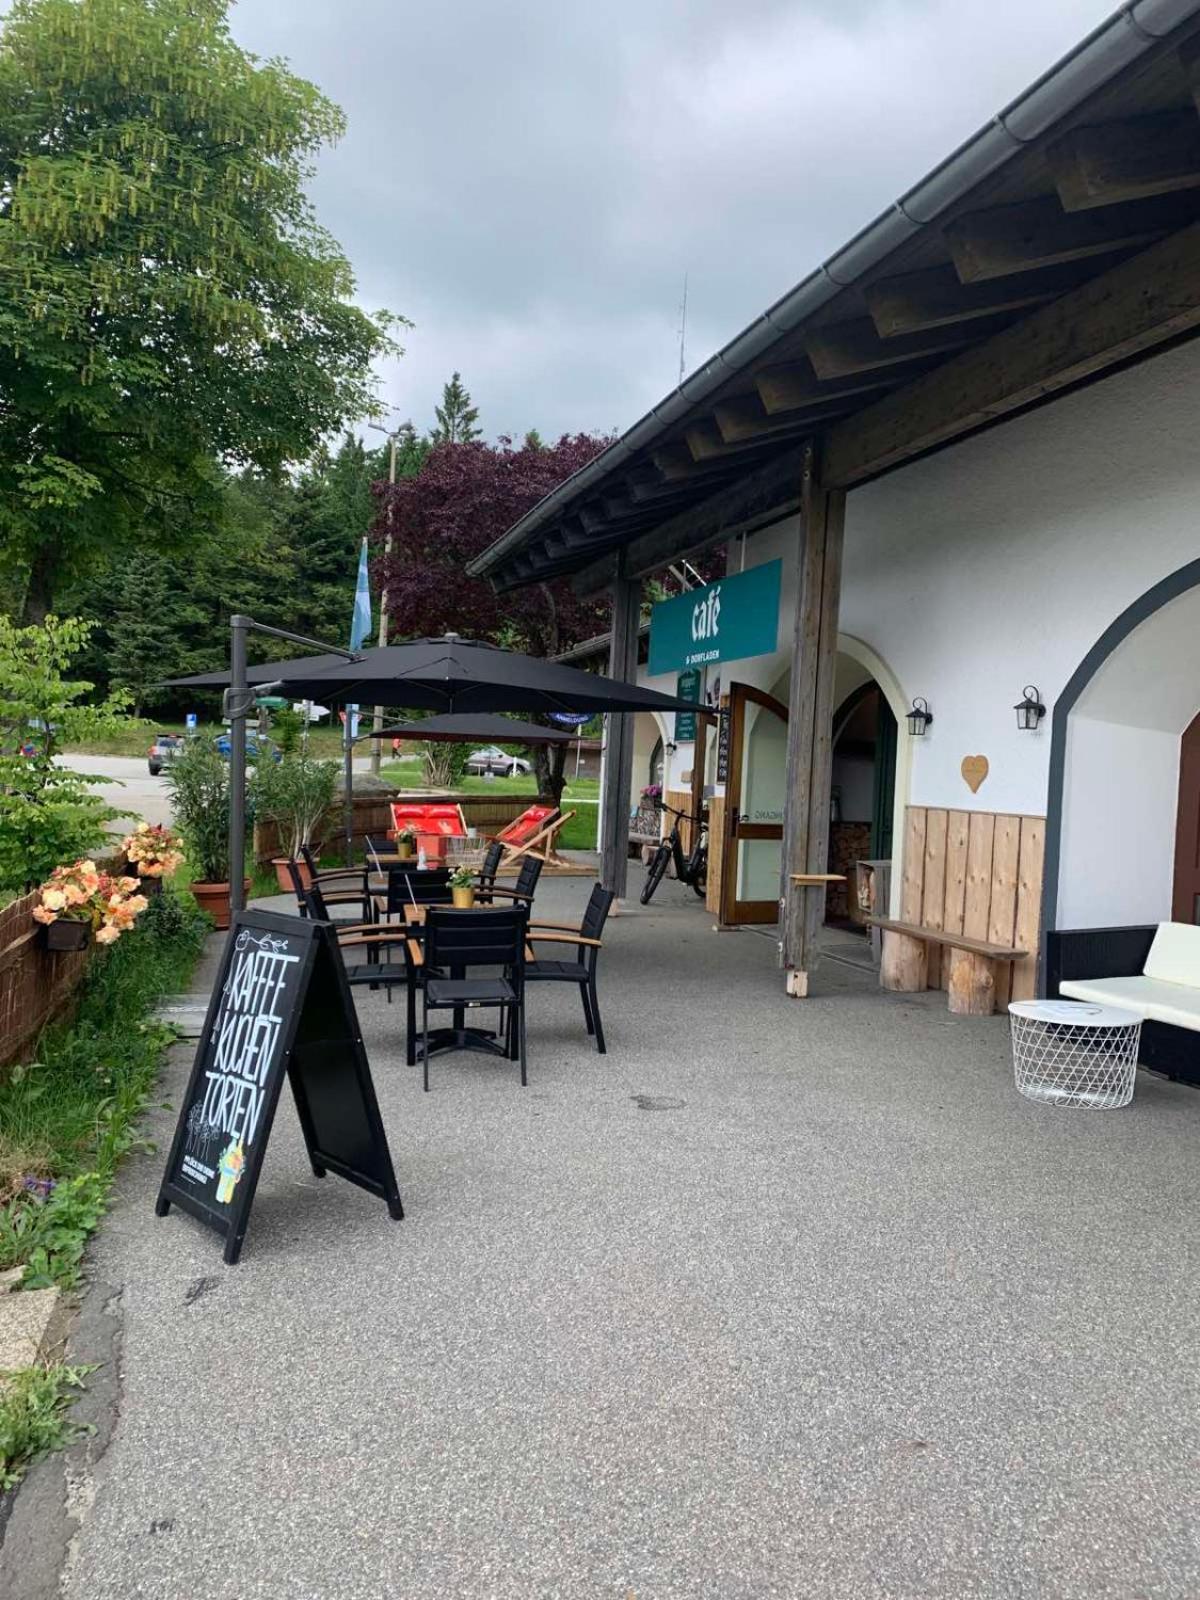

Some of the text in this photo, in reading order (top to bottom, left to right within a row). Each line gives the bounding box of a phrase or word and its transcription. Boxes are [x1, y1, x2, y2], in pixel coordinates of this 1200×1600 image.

[691, 585, 721, 642] café
[691, 649, 720, 664] DORFLADEN
[227, 950, 300, 1023] KAFFEE
[214, 1011, 281, 1087] KUCHEN
[200, 1070, 265, 1145] TORTEN
